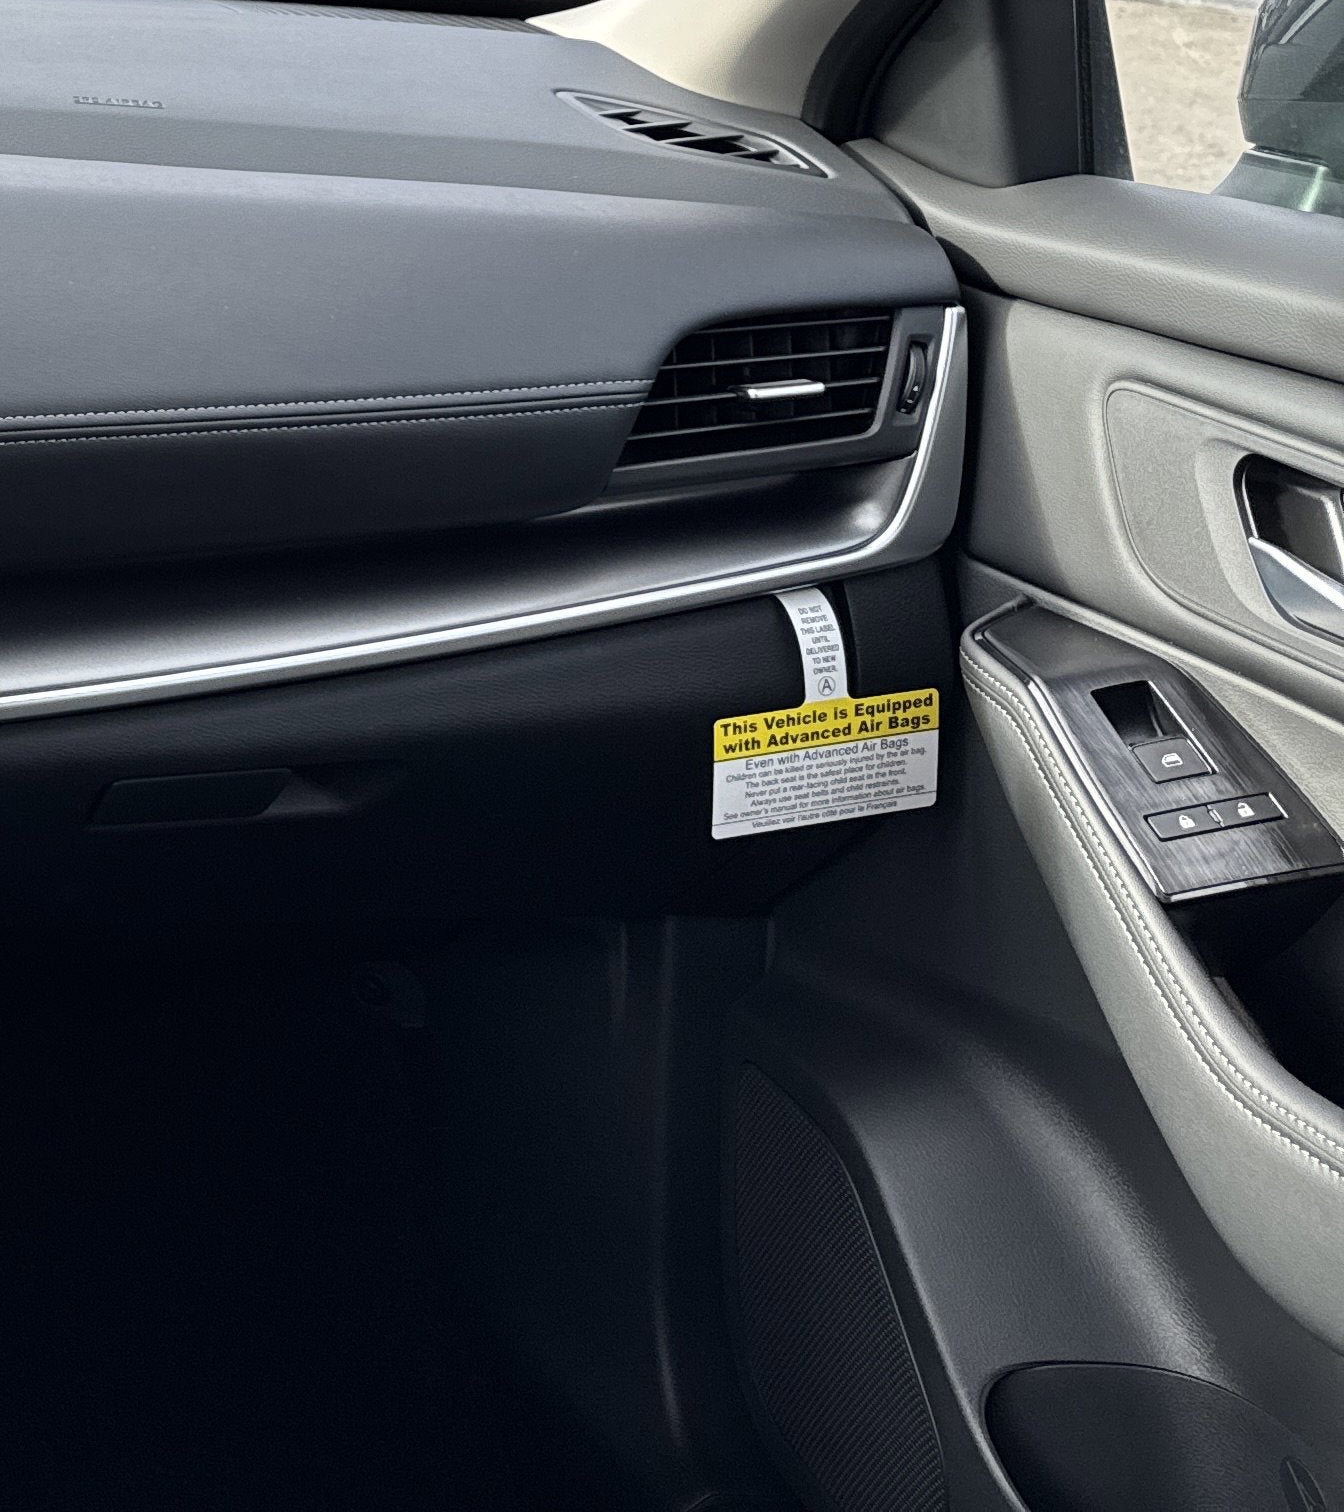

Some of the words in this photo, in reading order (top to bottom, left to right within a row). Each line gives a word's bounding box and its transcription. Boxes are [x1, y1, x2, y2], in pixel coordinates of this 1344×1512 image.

[720, 721, 758, 736] This
[764, 710, 827, 730] Vehicle
[833, 707, 848, 720] is
[855, 693, 933, 717] Equipped
[723, 737, 761, 754] with
[767, 723, 851, 748] Advanced
[857, 719, 882, 734] Air
[888, 714, 930, 729] Bags
[726, 772, 756, 783] Children
[758, 770, 772, 778] can
[785, 765, 804, 774] killed
[815, 757, 847, 769] seriously
[850, 753, 874, 764] injured
[876, 752, 884, 761] by
[887, 749, 898, 758] the
[900, 749, 909, 757] air
[746, 757, 774, 770] Even
[777, 752, 800, 765] with
[803, 744, 858, 761] Advanced
[861, 741, 877, 752] Air
[881, 738, 908, 750] Bags
